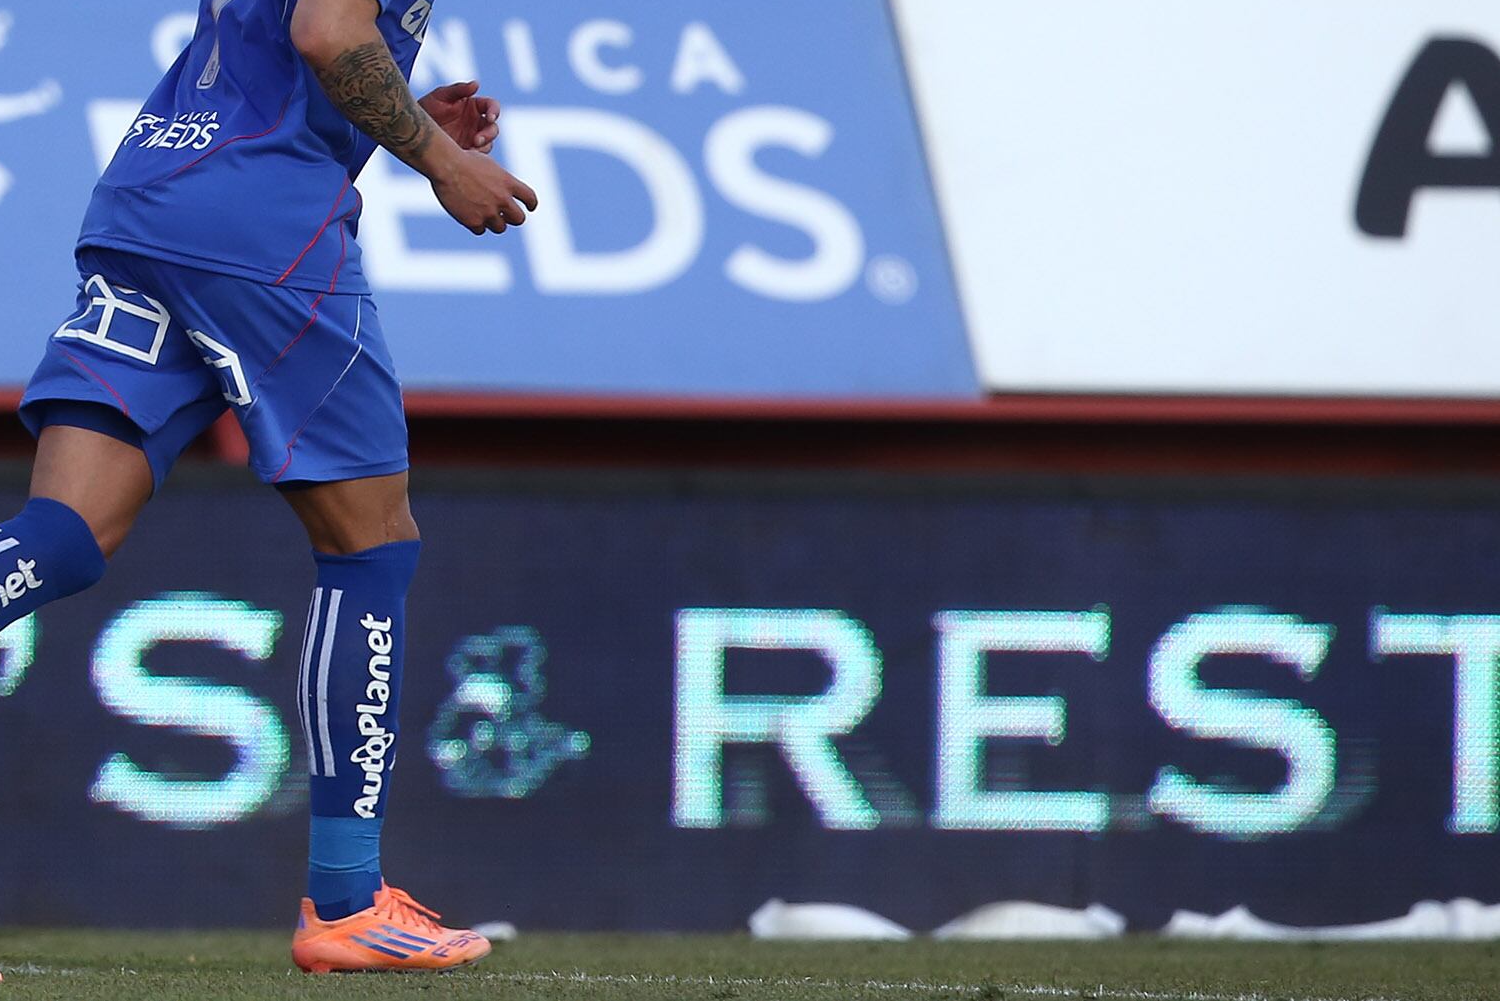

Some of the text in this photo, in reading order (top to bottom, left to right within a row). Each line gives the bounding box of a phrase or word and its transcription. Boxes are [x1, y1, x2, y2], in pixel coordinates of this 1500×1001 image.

[87, 98, 866, 303] EDS
[1351, 34, 1500, 242] A
[349, 612, 396, 820] AutoPlanet
[672, 604, 1500, 839] REST
